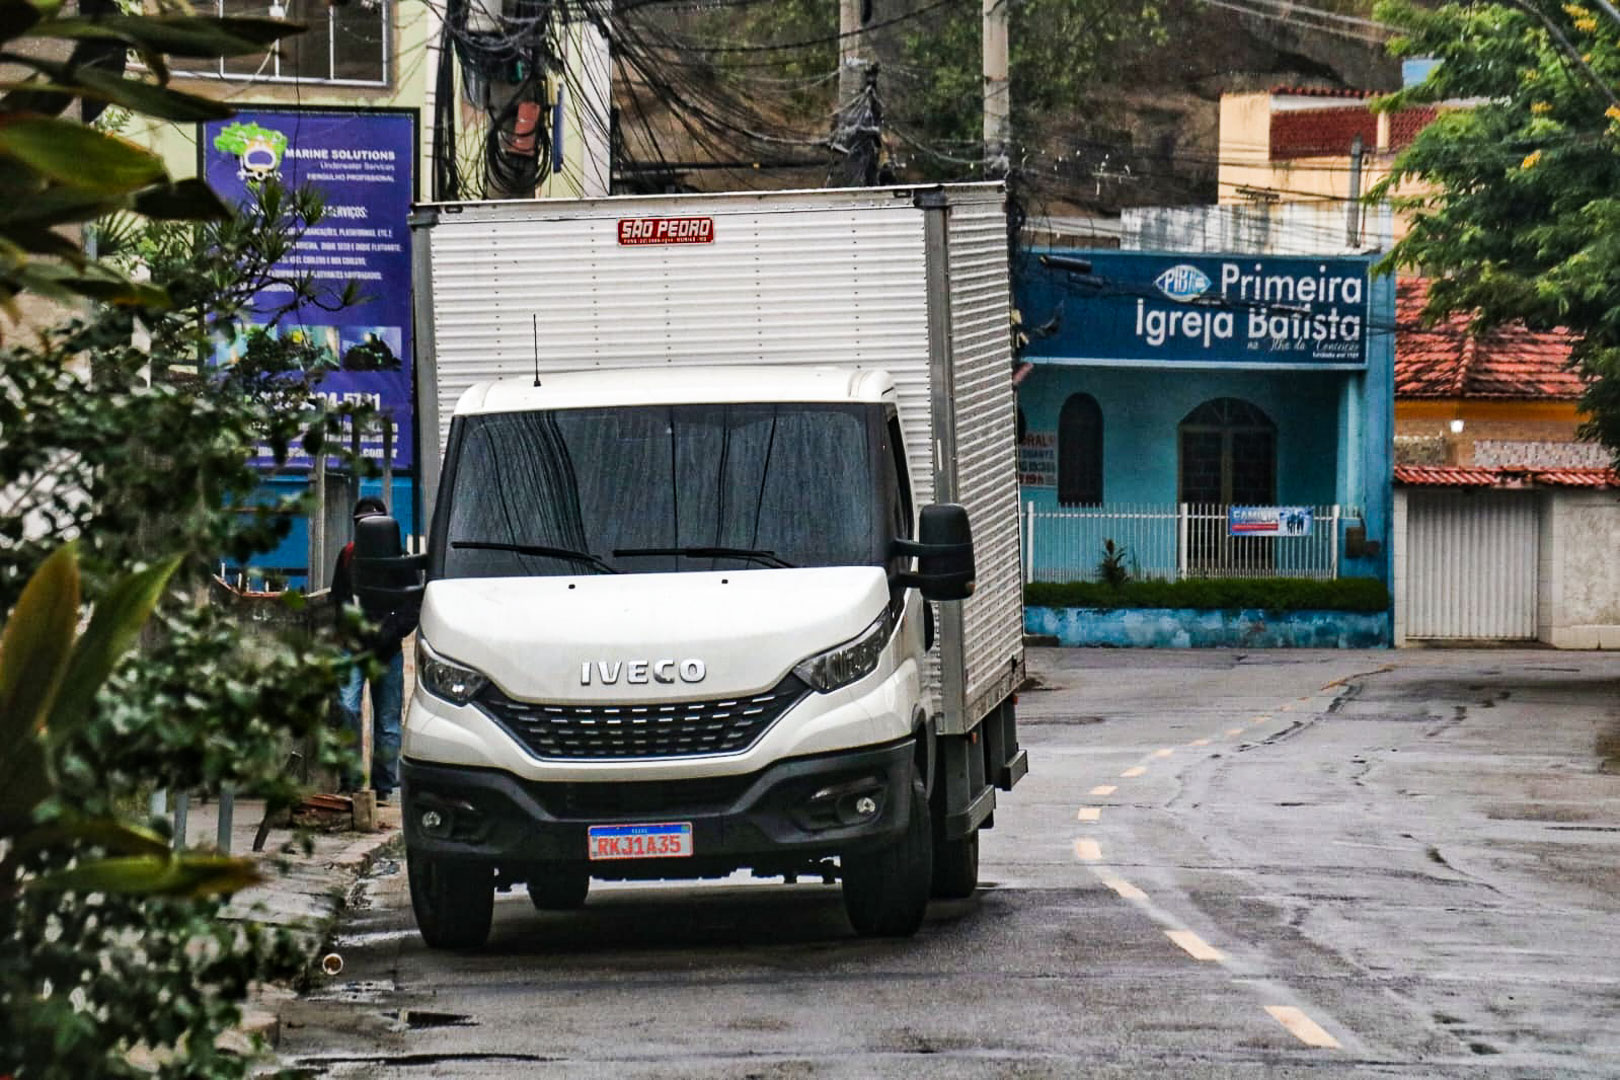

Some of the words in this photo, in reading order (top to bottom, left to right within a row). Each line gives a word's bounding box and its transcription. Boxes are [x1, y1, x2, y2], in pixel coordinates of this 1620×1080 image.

[285, 148, 329, 160] MARINE
[331, 149, 396, 160] SOLUTIONS
[320, 161, 362, 170] Underwater
[621, 218, 653, 238] SÃO
[656, 219, 711, 238] PEDRO
[1221, 263, 1363, 304] Primeira
[1135, 298, 1234, 348] Igreja
[1247, 304, 1361, 342] Batista
[580, 659, 707, 687] IVECO
[598, 834, 682, 856] RKJ1A35
